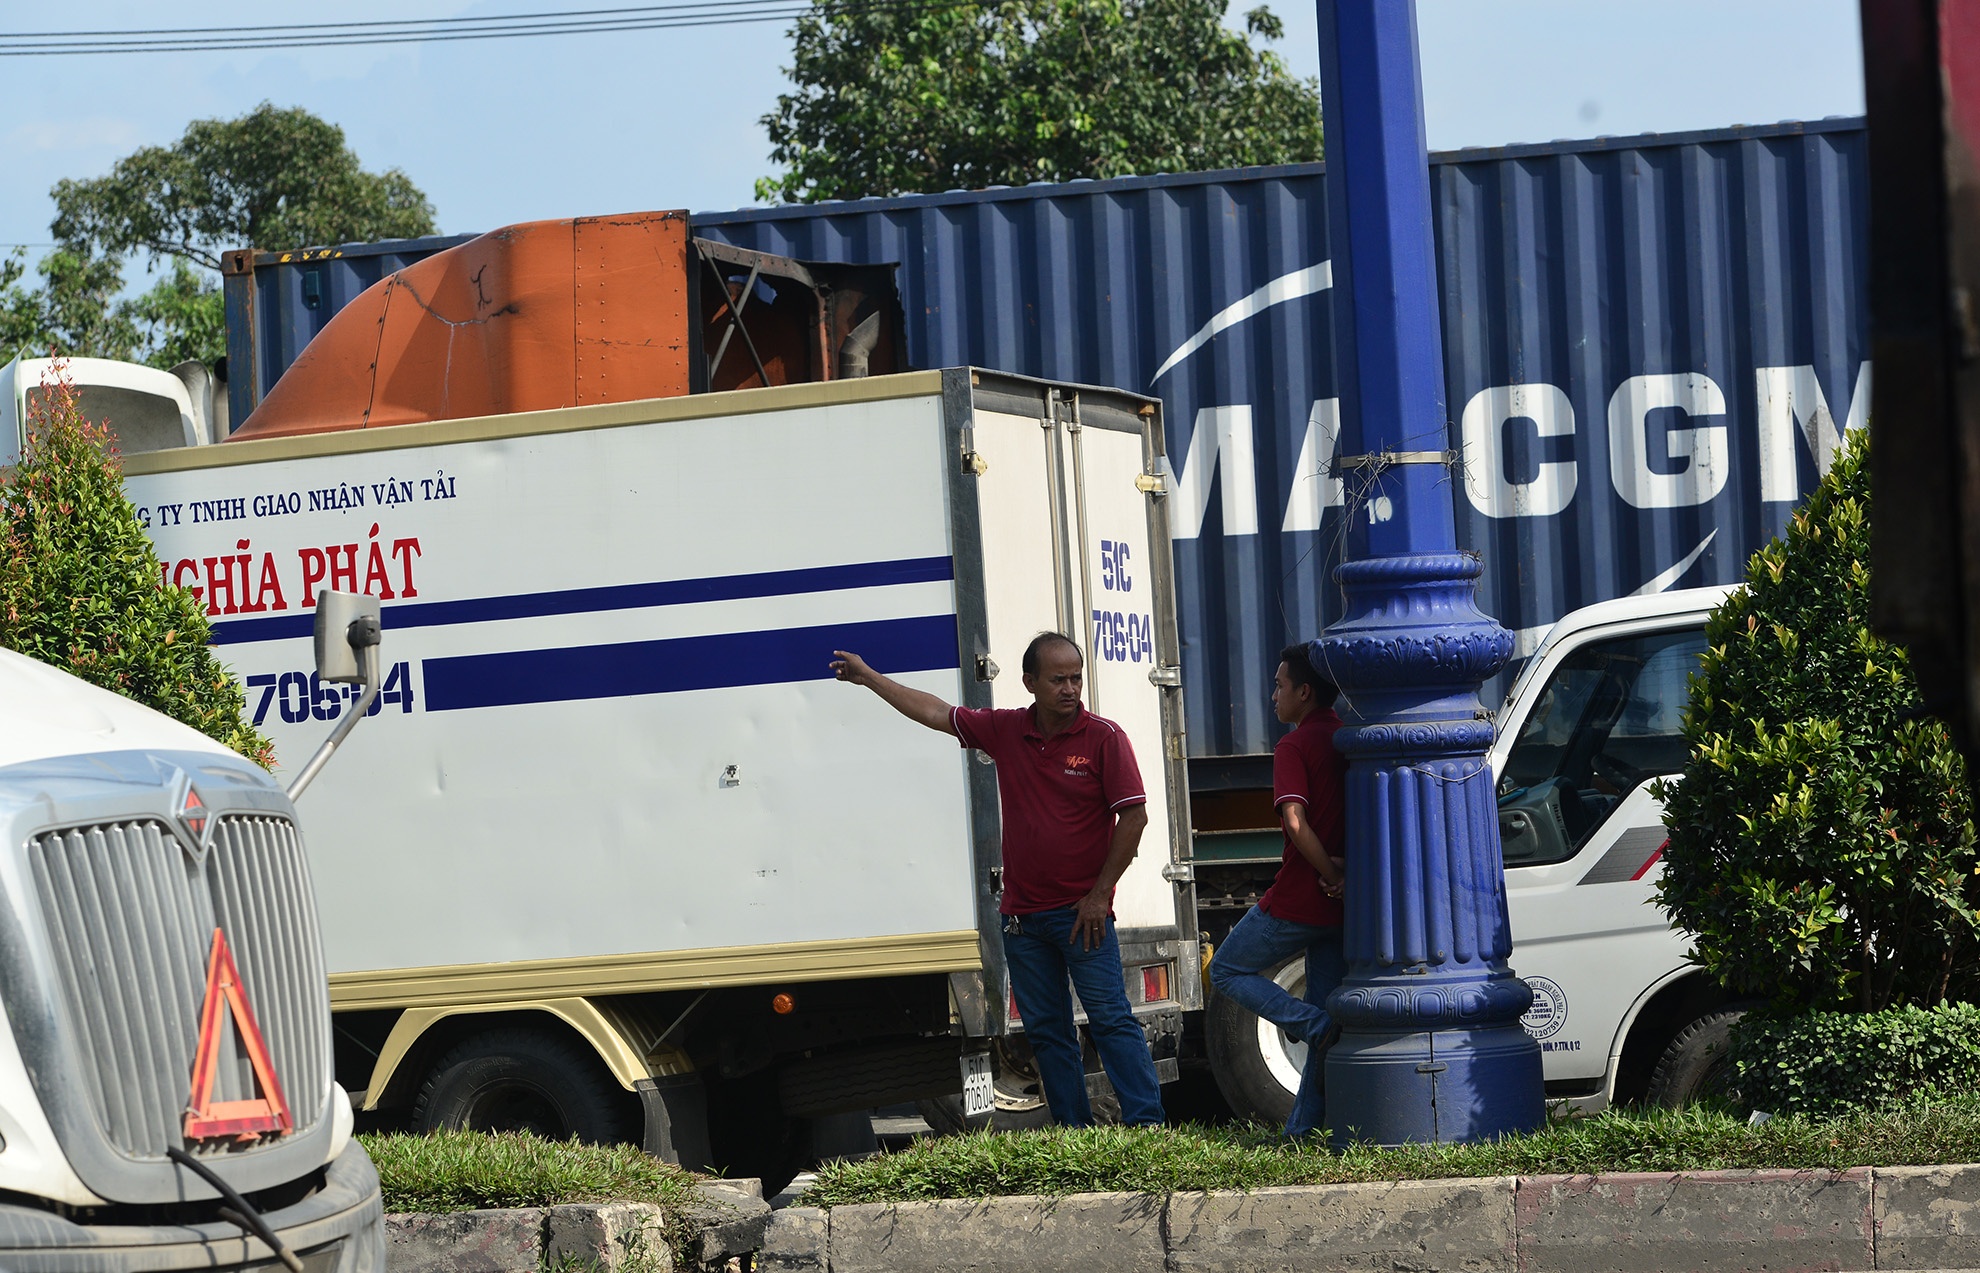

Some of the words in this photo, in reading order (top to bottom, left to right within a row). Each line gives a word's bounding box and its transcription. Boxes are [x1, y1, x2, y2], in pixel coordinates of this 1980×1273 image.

[157, 503, 183, 527] TY
[189, 498, 246, 523] TNHH
[253, 492, 301, 518] GIAO
[308, 482, 365, 515] NHẬN
[371, 477, 414, 509] VẬN
[420, 469, 457, 501] TẢI
[298, 522, 423, 609] PHÁT
[1101, 540, 1132, 593] 51C
[968, 1057, 985, 1084] 51C
